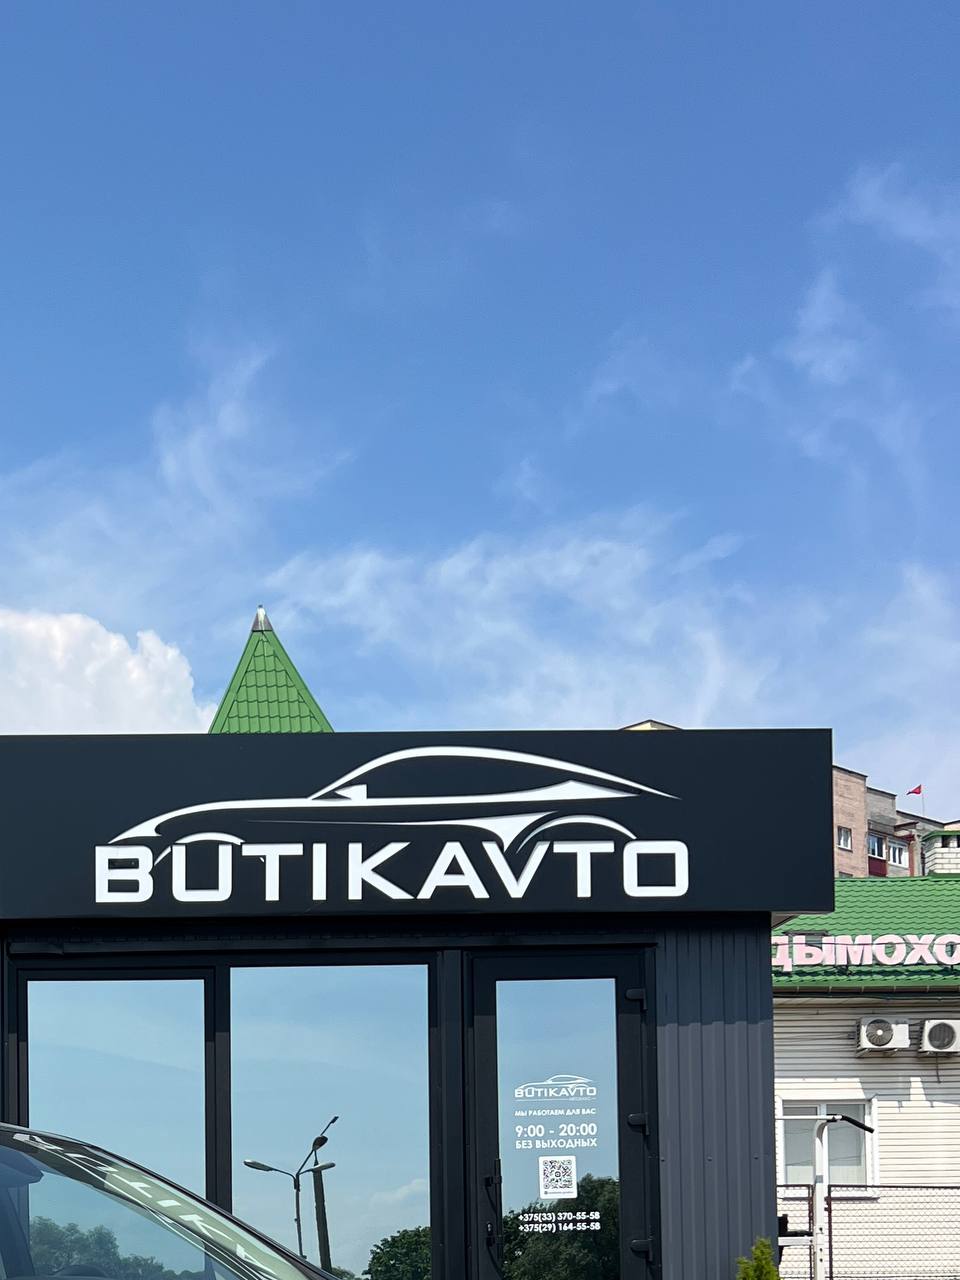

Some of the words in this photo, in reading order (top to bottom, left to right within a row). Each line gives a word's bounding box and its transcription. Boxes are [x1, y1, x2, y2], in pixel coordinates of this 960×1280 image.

[95, 838, 689, 903] BUTIKAVTO
[514, 1087, 597, 1098] BUTIKAVTO
[566, 1108, 581, 1116] ДЛЯ
[515, 1124, 545, 1138] 9:00
[559, 1123, 598, 1137] 20:00
[515, 1140, 533, 1149] БЕЗ
[535, 1138, 598, 1149] ВЫХОДНЫХ
[518, 1212, 556, 1222] +375(33)
[557, 1211, 600, 1220] 370-55-58
[518, 1223, 557, 1233] +375(29)
[558, 1222, 601, 1231] 164-55-58
